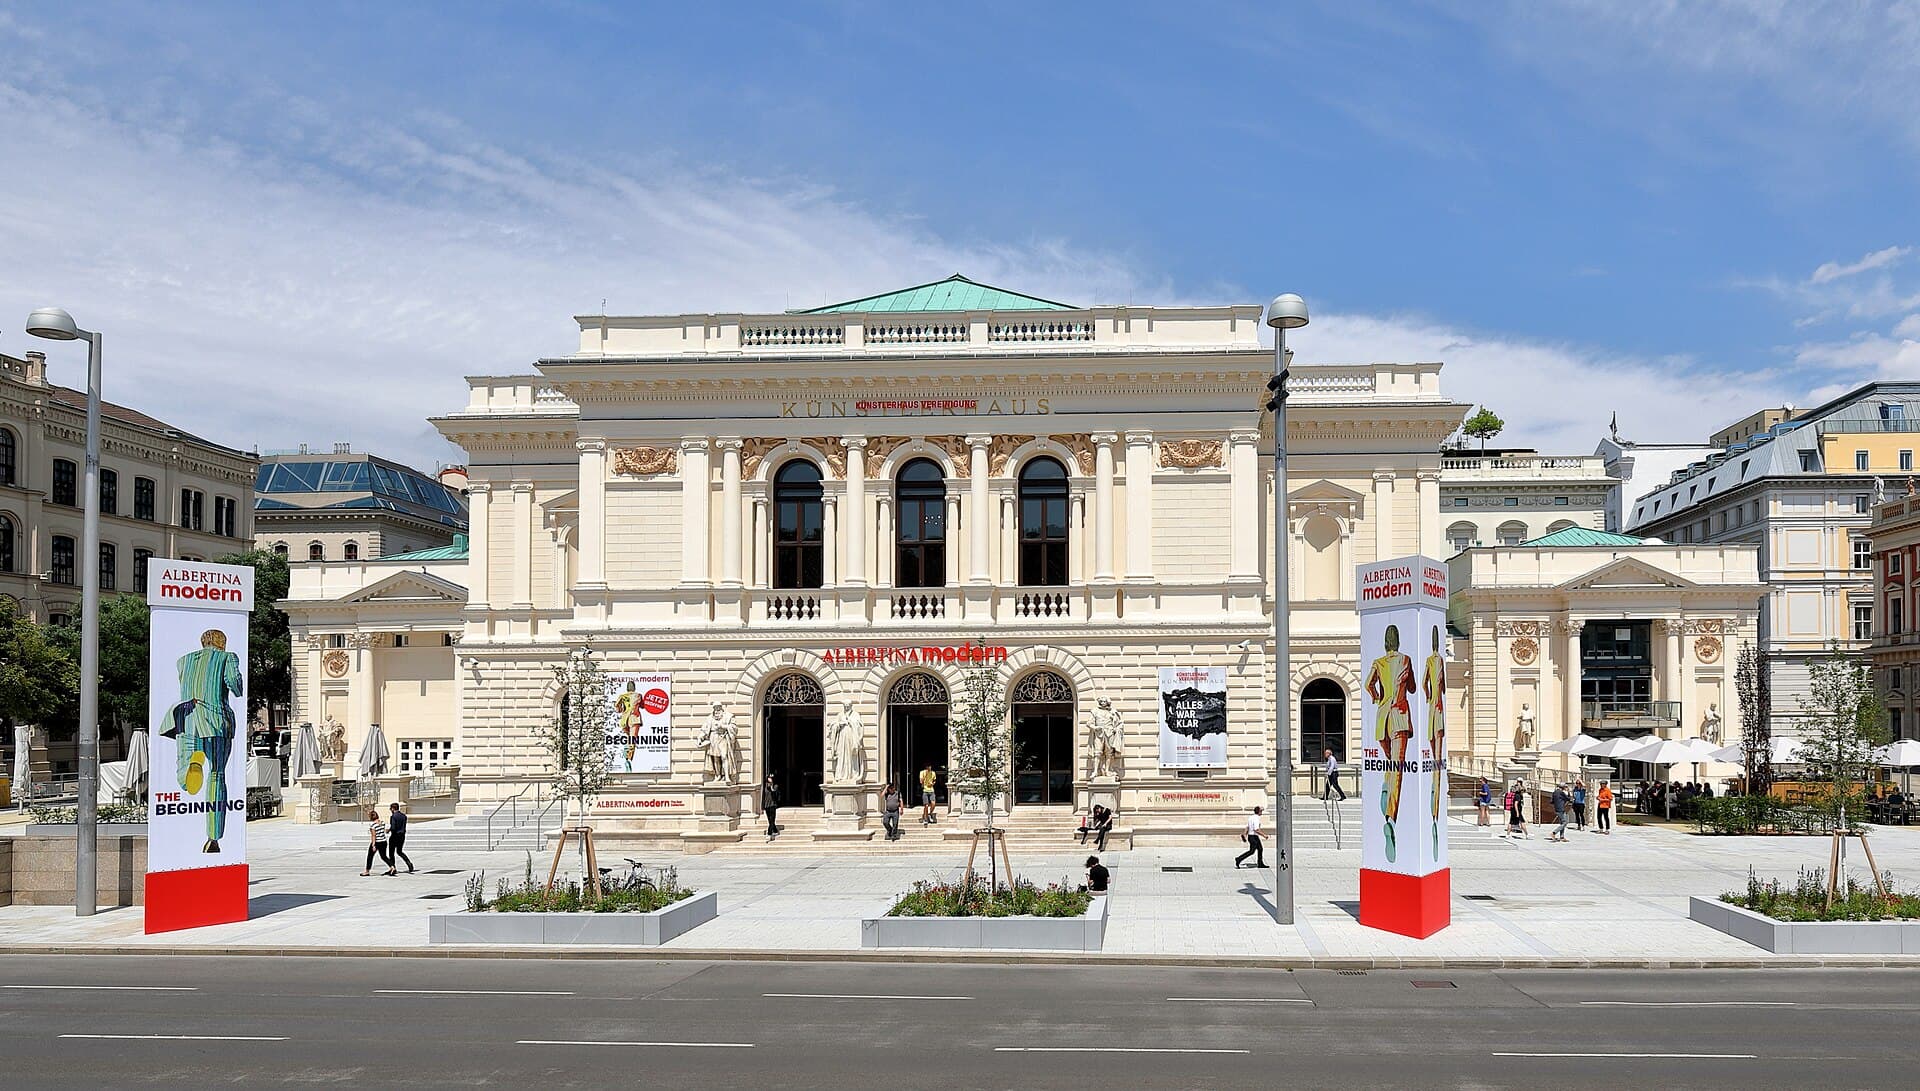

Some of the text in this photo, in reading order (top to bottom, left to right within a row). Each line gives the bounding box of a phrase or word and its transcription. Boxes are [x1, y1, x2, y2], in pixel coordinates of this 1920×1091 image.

[856, 400, 976, 409] KÜNSTLERHAUS VEREINIGUNG
[162, 569, 242, 585] ALBERTINA
[1363, 567, 1412, 584] ALBERTINA
[1423, 567, 1446, 583] ALBERTINA
[161, 584, 242, 602] modern
[1363, 581, 1412, 600] modern
[1423, 581, 1447, 599] modern
[822, 642, 1007, 663] ALBERTINA modern
[645, 694, 668, 704] JETZT
[1176, 701, 1203, 710] ALLES
[1176, 710, 1196, 719] WAR
[1176, 719, 1199, 728] KLAR
[651, 726, 669, 734] THE
[605, 735, 669, 745] BEGINNING
[1364, 749, 1379, 758] THE
[1422, 749, 1430, 759] THE
[1364, 760, 1418, 773] BEGINNING
[155, 792, 181, 802] THE
[155, 799, 245, 816] BEGINNING
[596, 800, 635, 808] ALBERTINA
[636, 799, 670, 808] modern
